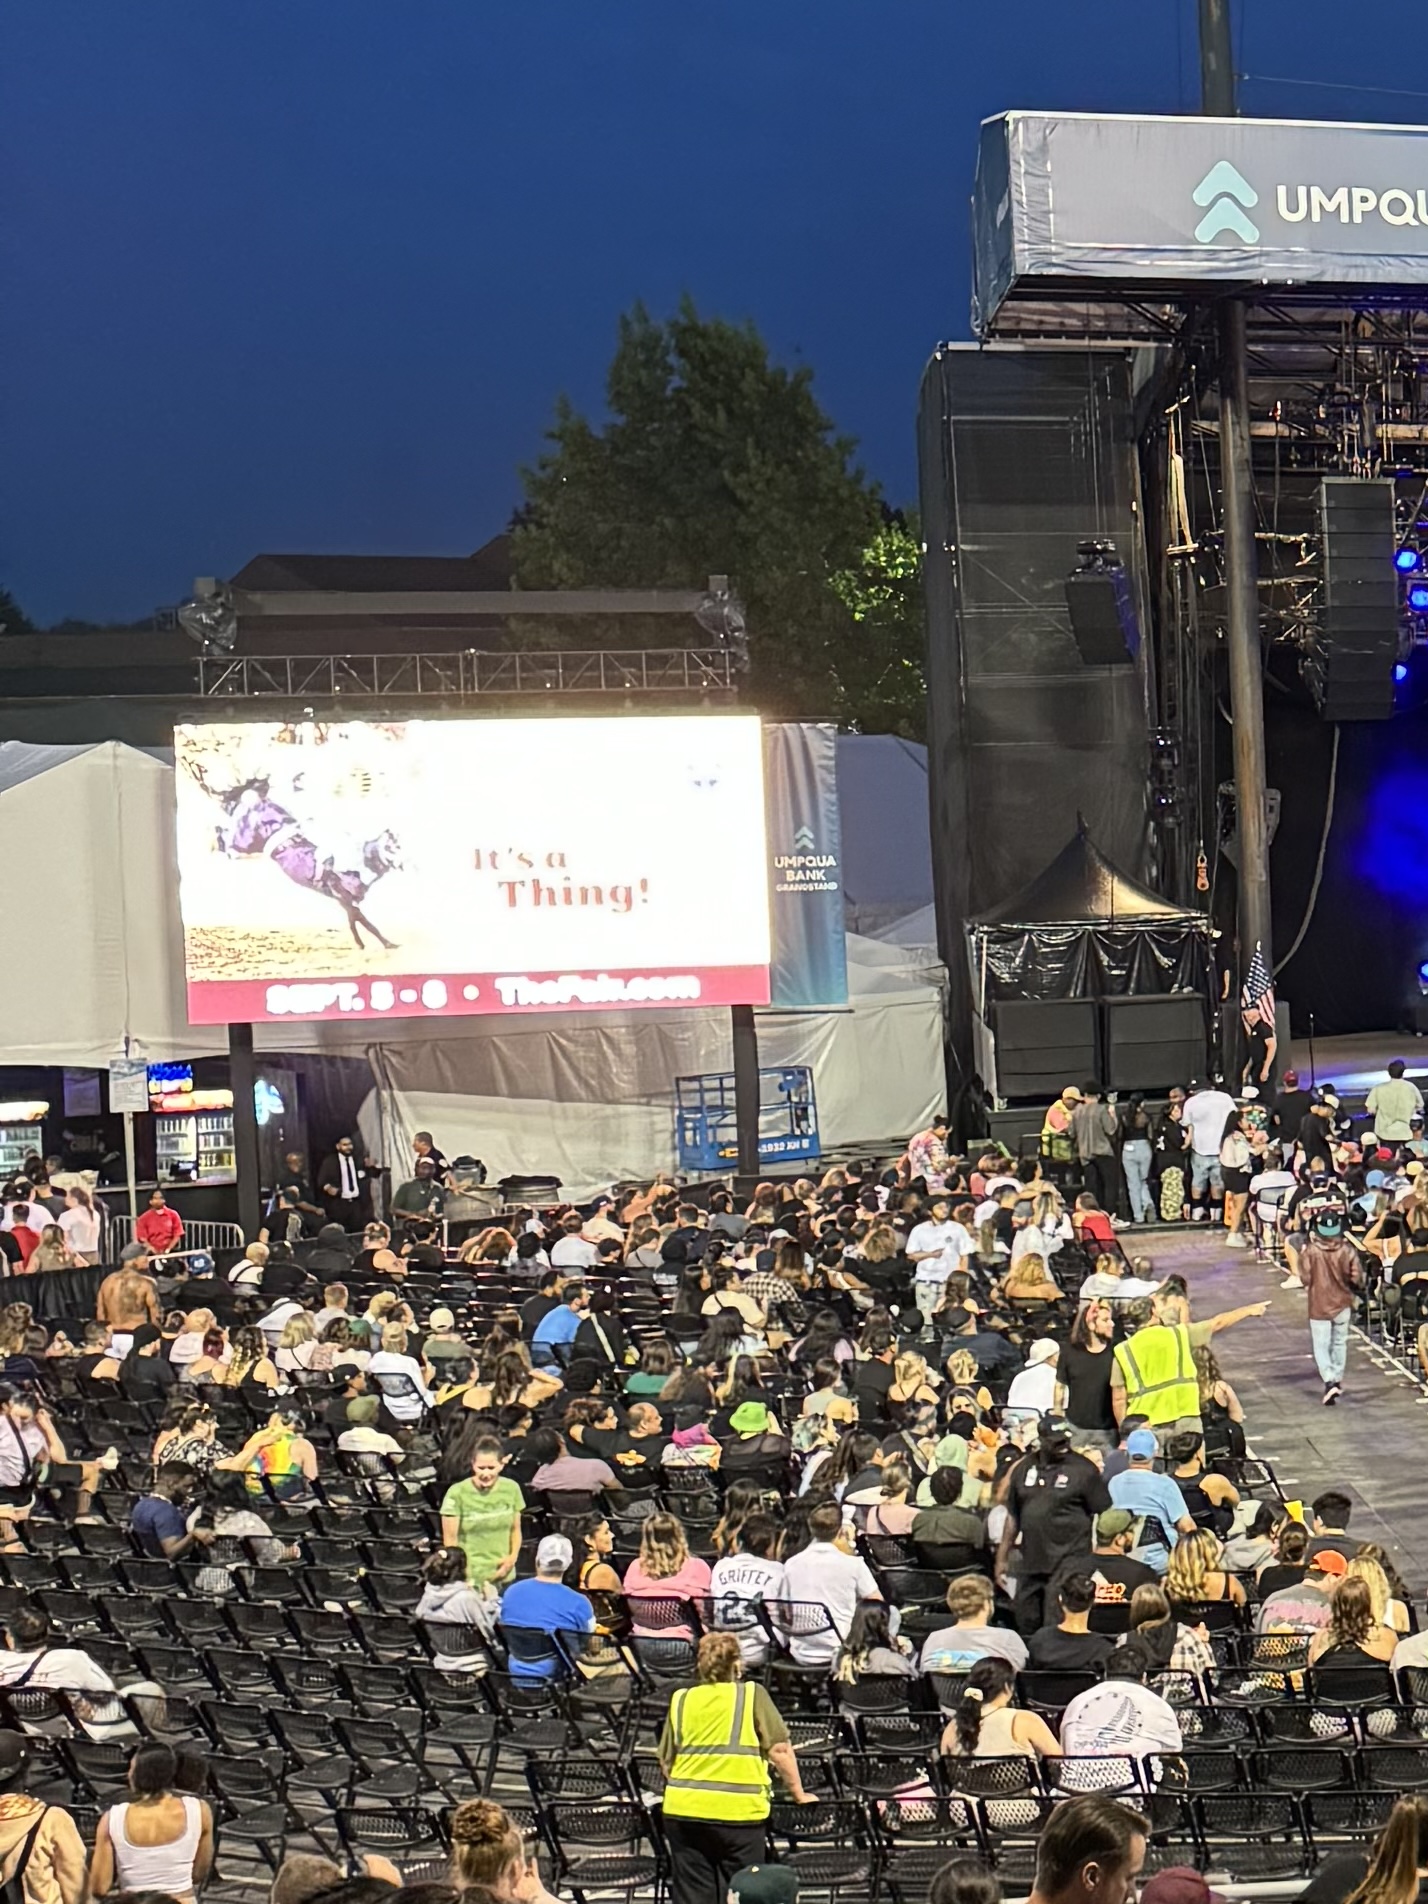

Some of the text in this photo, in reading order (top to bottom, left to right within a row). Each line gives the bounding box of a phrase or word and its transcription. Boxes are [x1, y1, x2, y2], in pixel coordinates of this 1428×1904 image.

[474, 846, 567, 871] It's a
[773, 855, 838, 869] UMPQUA
[785, 868, 827, 882] BANK
[498, 876, 650, 914] Thing!
[718, 1567, 774, 1586] GRIFFEY
